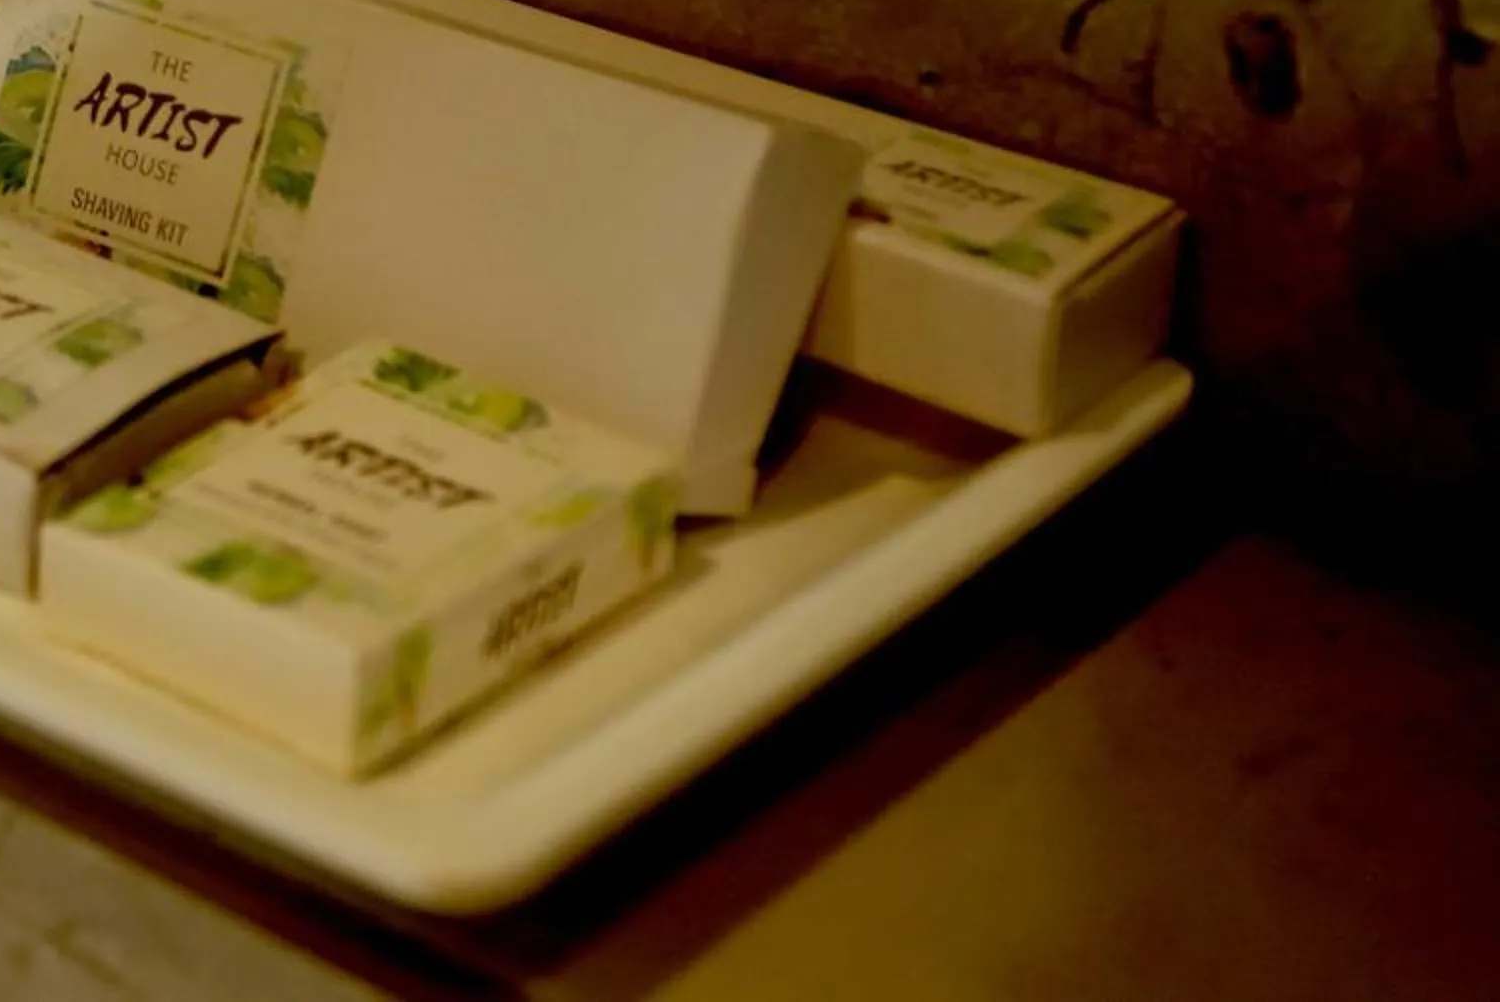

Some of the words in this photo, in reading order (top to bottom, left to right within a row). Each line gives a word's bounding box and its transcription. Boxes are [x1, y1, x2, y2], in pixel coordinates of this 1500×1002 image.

[151, 50, 193, 83] THE
[74, 71, 243, 160] ARTIST
[105, 144, 182, 185] HOUSE
[71, 186, 153, 235] SHAVING
[156, 217, 189, 247] KIT
